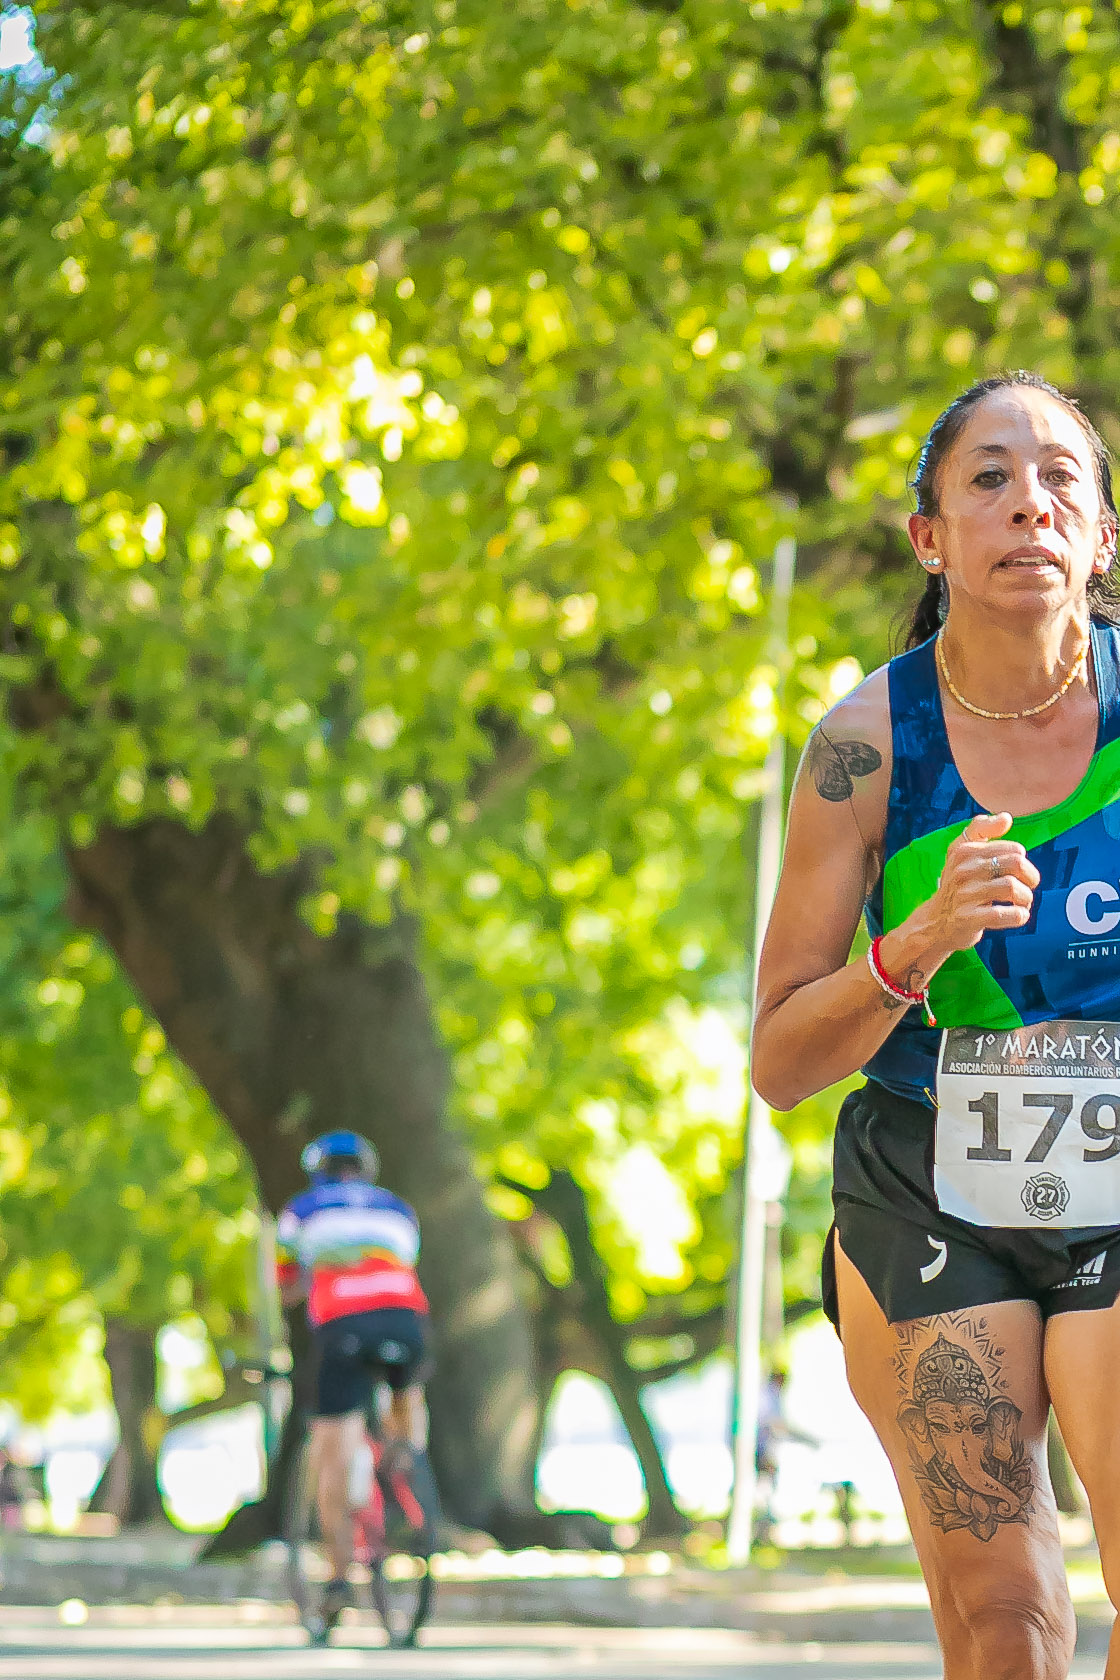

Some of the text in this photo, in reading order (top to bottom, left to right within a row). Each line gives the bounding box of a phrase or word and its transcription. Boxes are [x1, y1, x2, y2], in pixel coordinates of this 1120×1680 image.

[949, 1061, 1001, 1075] ASOCIACIÓN
[1003, 1064, 1052, 1077] BOMBEROS
[1054, 1065, 1114, 1078] VOLUNTARIOS
[1036, 1186, 1056, 1204] 27
